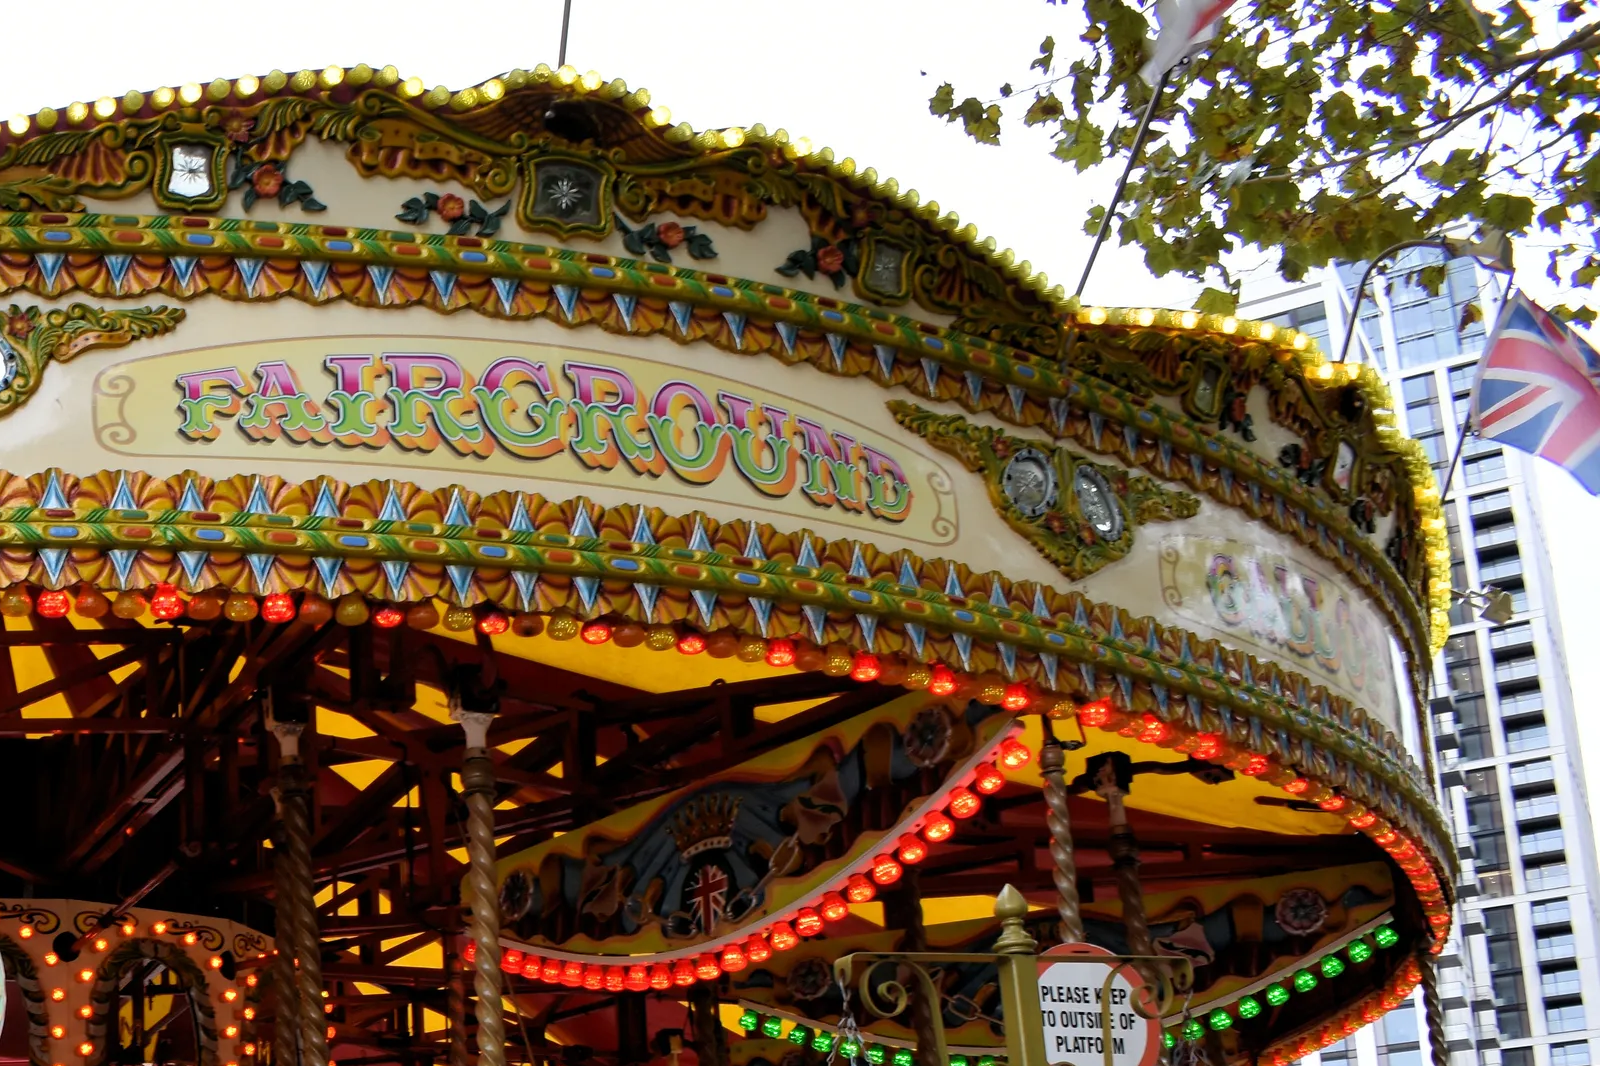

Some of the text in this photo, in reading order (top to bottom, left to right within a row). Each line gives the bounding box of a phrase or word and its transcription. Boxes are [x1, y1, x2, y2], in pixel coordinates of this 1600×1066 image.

[176, 351, 915, 524] FAIRGROUND
[1041, 985, 1127, 1005] PLEASE KEP
[1042, 1010, 1136, 1030] TO OUTSIE OF
[1055, 1035, 1125, 1054] PLATFOM
